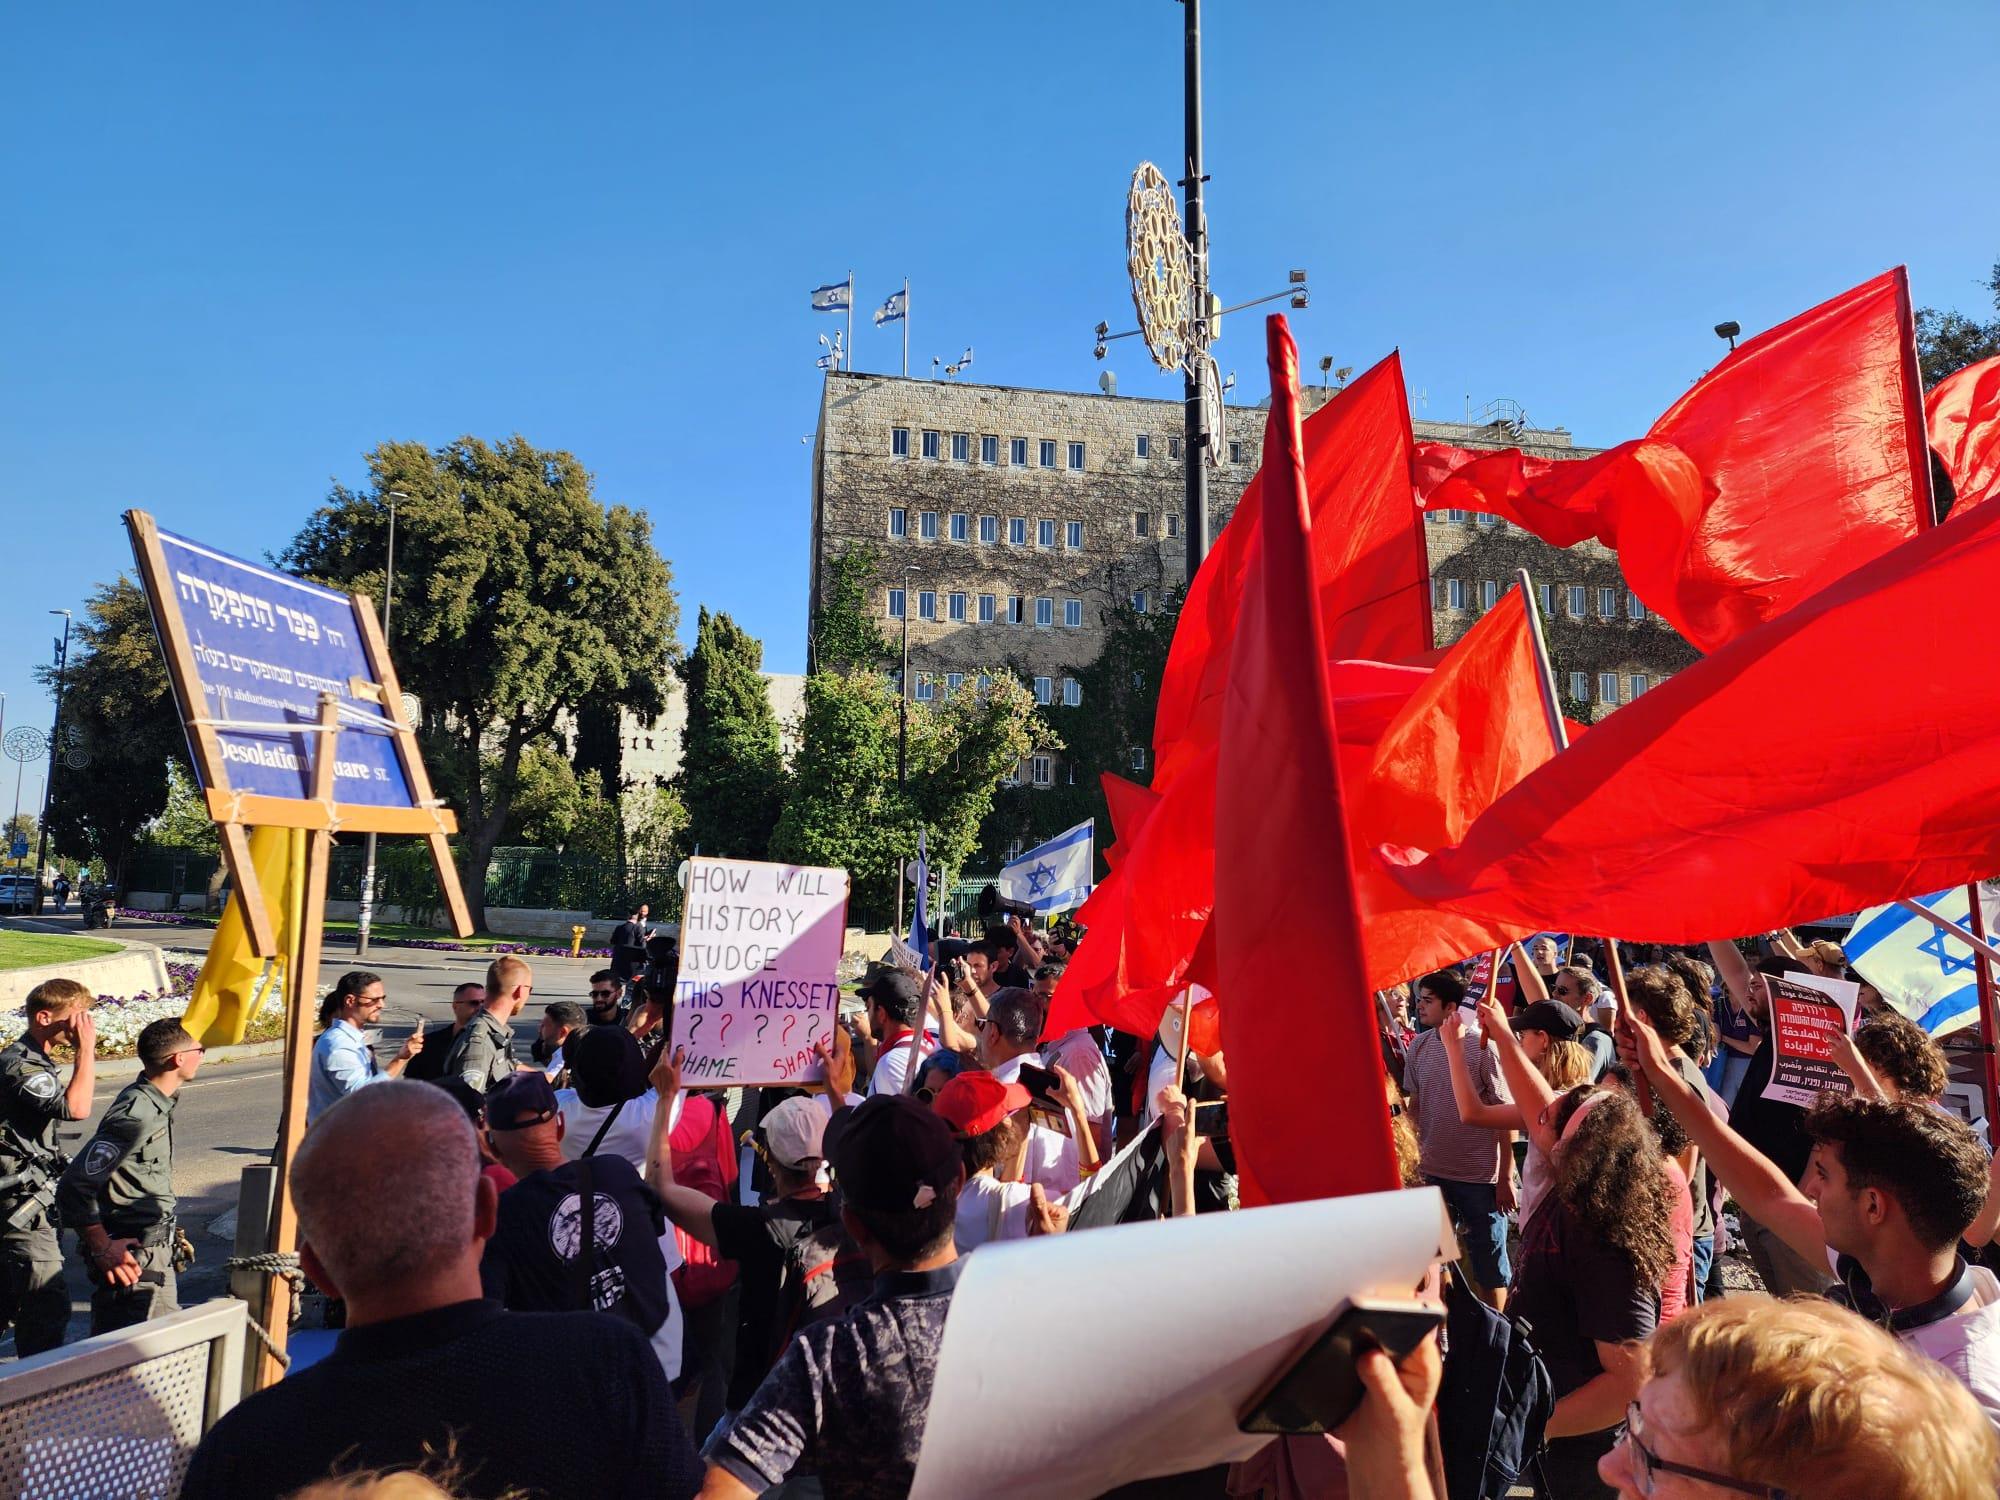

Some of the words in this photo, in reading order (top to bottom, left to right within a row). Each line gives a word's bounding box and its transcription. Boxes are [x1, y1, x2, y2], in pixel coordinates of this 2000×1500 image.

[201, 680, 216, 695] he
[233, 688, 278, 708] abductees
[691, 865, 751, 894] HOW
[776, 870, 830, 896] WILL
[688, 903, 804, 935] HISTORY
[688, 943, 779, 972] JUDGE
[677, 980, 724, 1009] THIS
[741, 979, 838, 1011] KNESSET
[689, 1013, 703, 1045] ?
[720, 1012, 733, 1048] ?
[754, 1013, 769, 1044] ?
[782, 1013, 796, 1047] ?
[807, 1013, 820, 1043] ?
